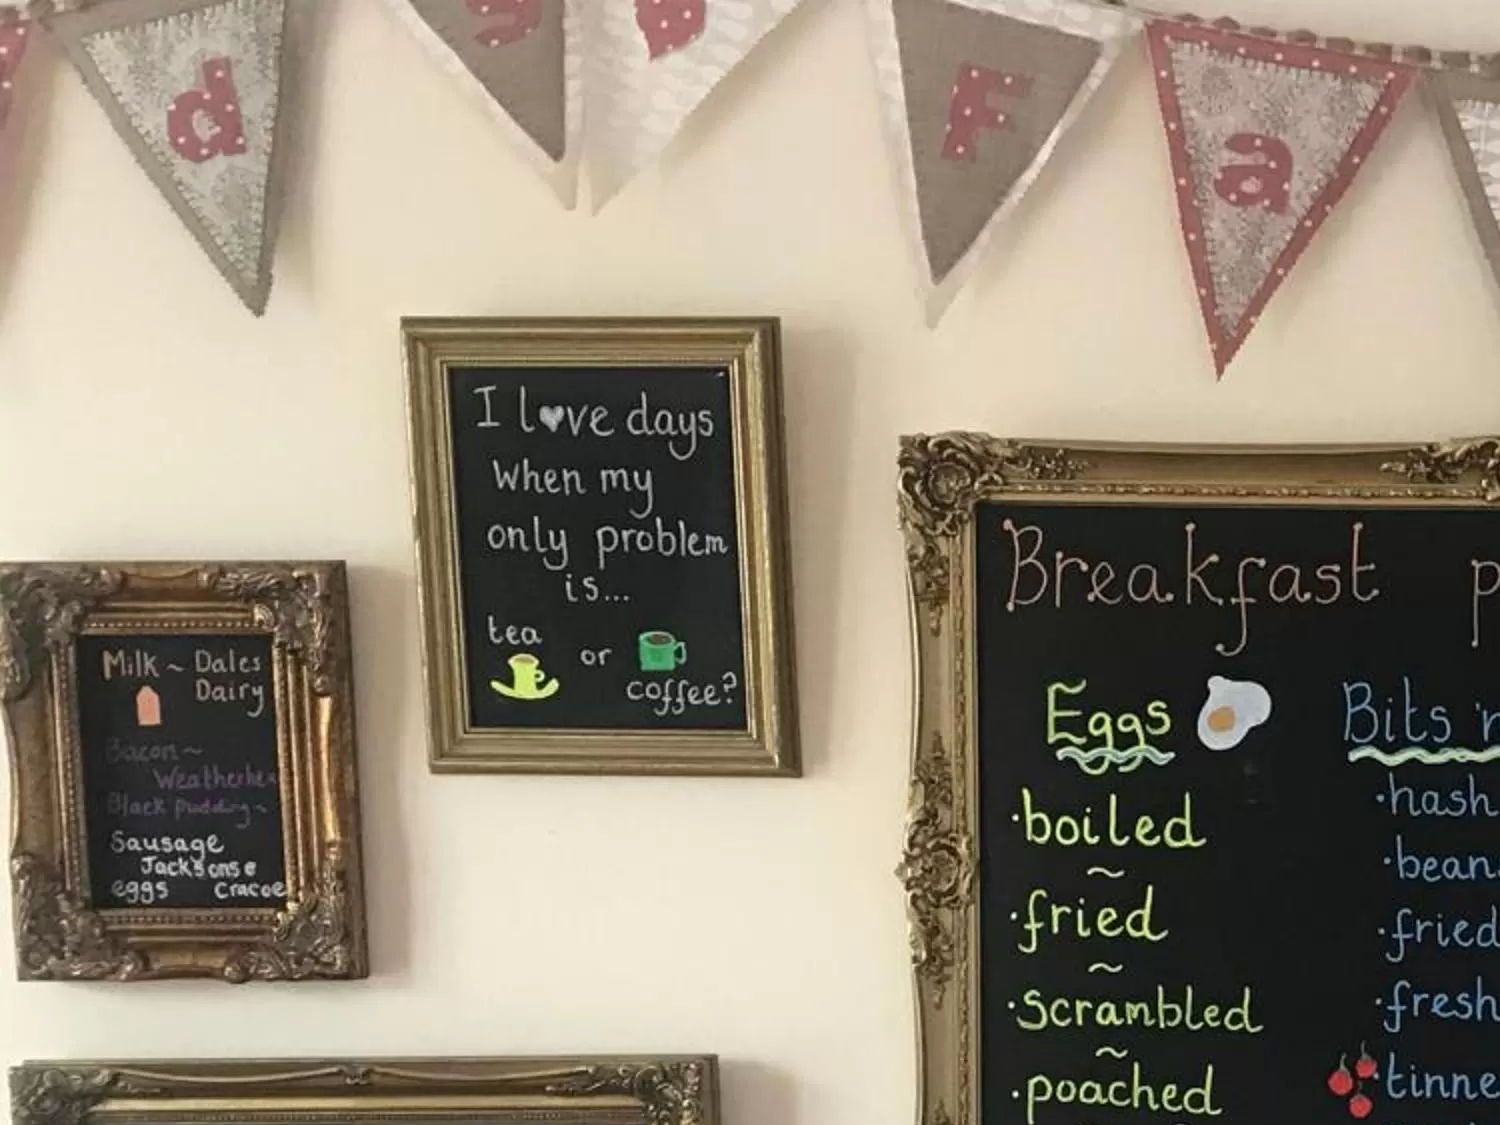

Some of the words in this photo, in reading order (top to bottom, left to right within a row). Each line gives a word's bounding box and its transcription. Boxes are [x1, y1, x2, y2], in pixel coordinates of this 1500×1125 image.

[473, 386, 500, 427] I
[626, 392, 713, 461] days
[600, 467, 652, 519] my
[487, 516, 568, 570] only
[596, 517, 728, 570] problem
[1003, 518, 1381, 657] Breakfast
[488, 615, 543, 645] tea
[102, 649, 160, 679] Milk
[194, 649, 261, 675] Dales
[580, 648, 613, 667] or
[195, 678, 265, 718] Dairy
[626, 671, 738, 716] coffee?
[1344, 676, 1451, 743] Bits
[1047, 679, 1173, 775] Eggs
[1021, 788, 1206, 848] boiled
[1389, 772, 1498, 817] hash
[111, 829, 224, 862] Sausage
[111, 879, 169, 905] eggs
[1018, 885, 1168, 953] fried
[1026, 1062, 1222, 1125] poached
